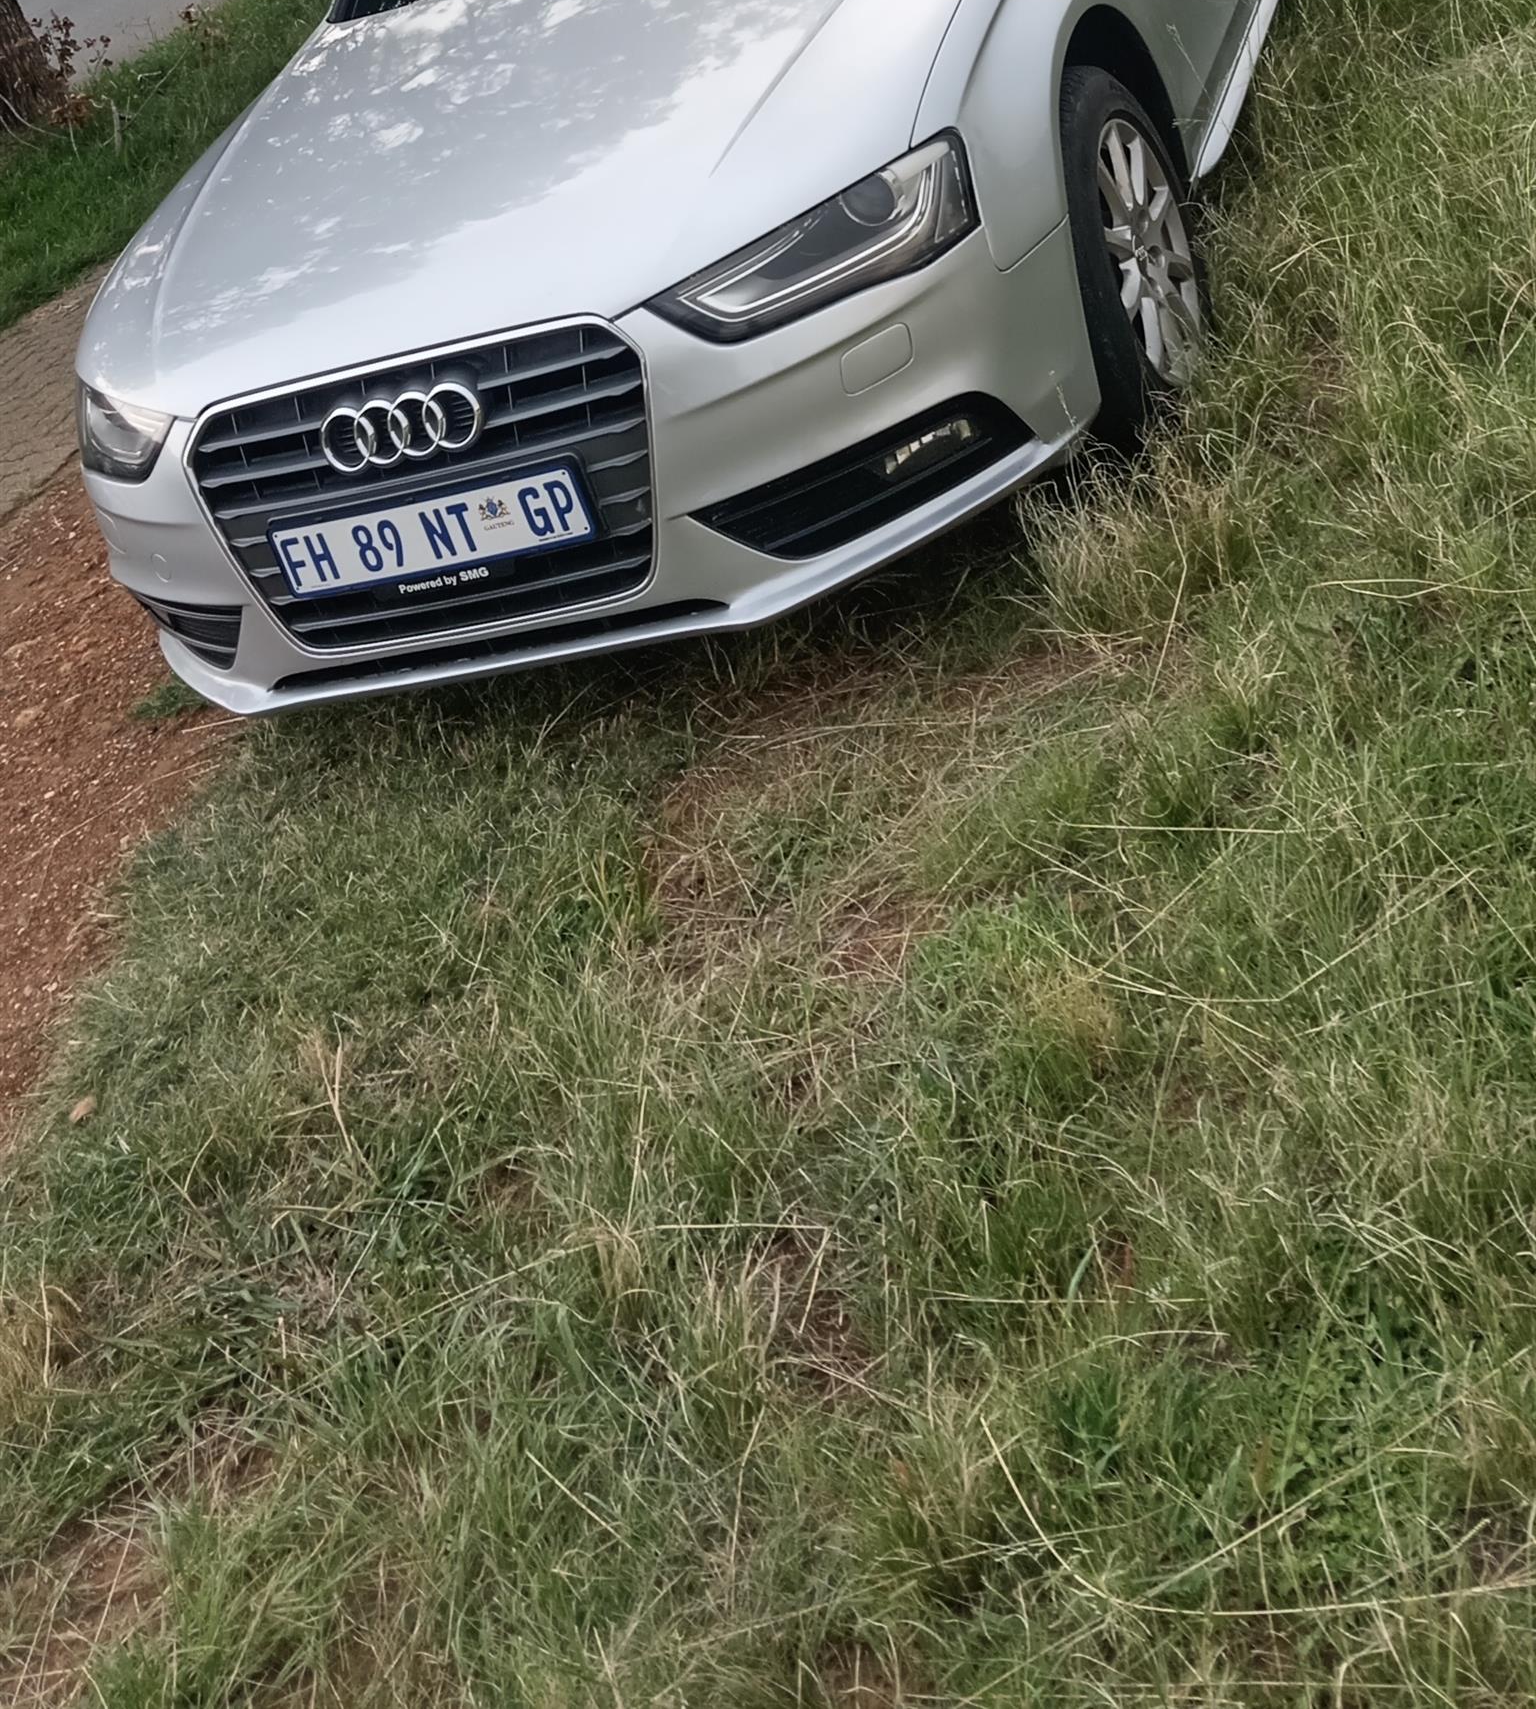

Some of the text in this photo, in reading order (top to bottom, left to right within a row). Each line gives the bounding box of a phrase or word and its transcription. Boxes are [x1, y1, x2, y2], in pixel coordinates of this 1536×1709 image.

[280, 480, 574, 587] FH 89 NT GP
[398, 567, 489, 594] Powered by SMG
